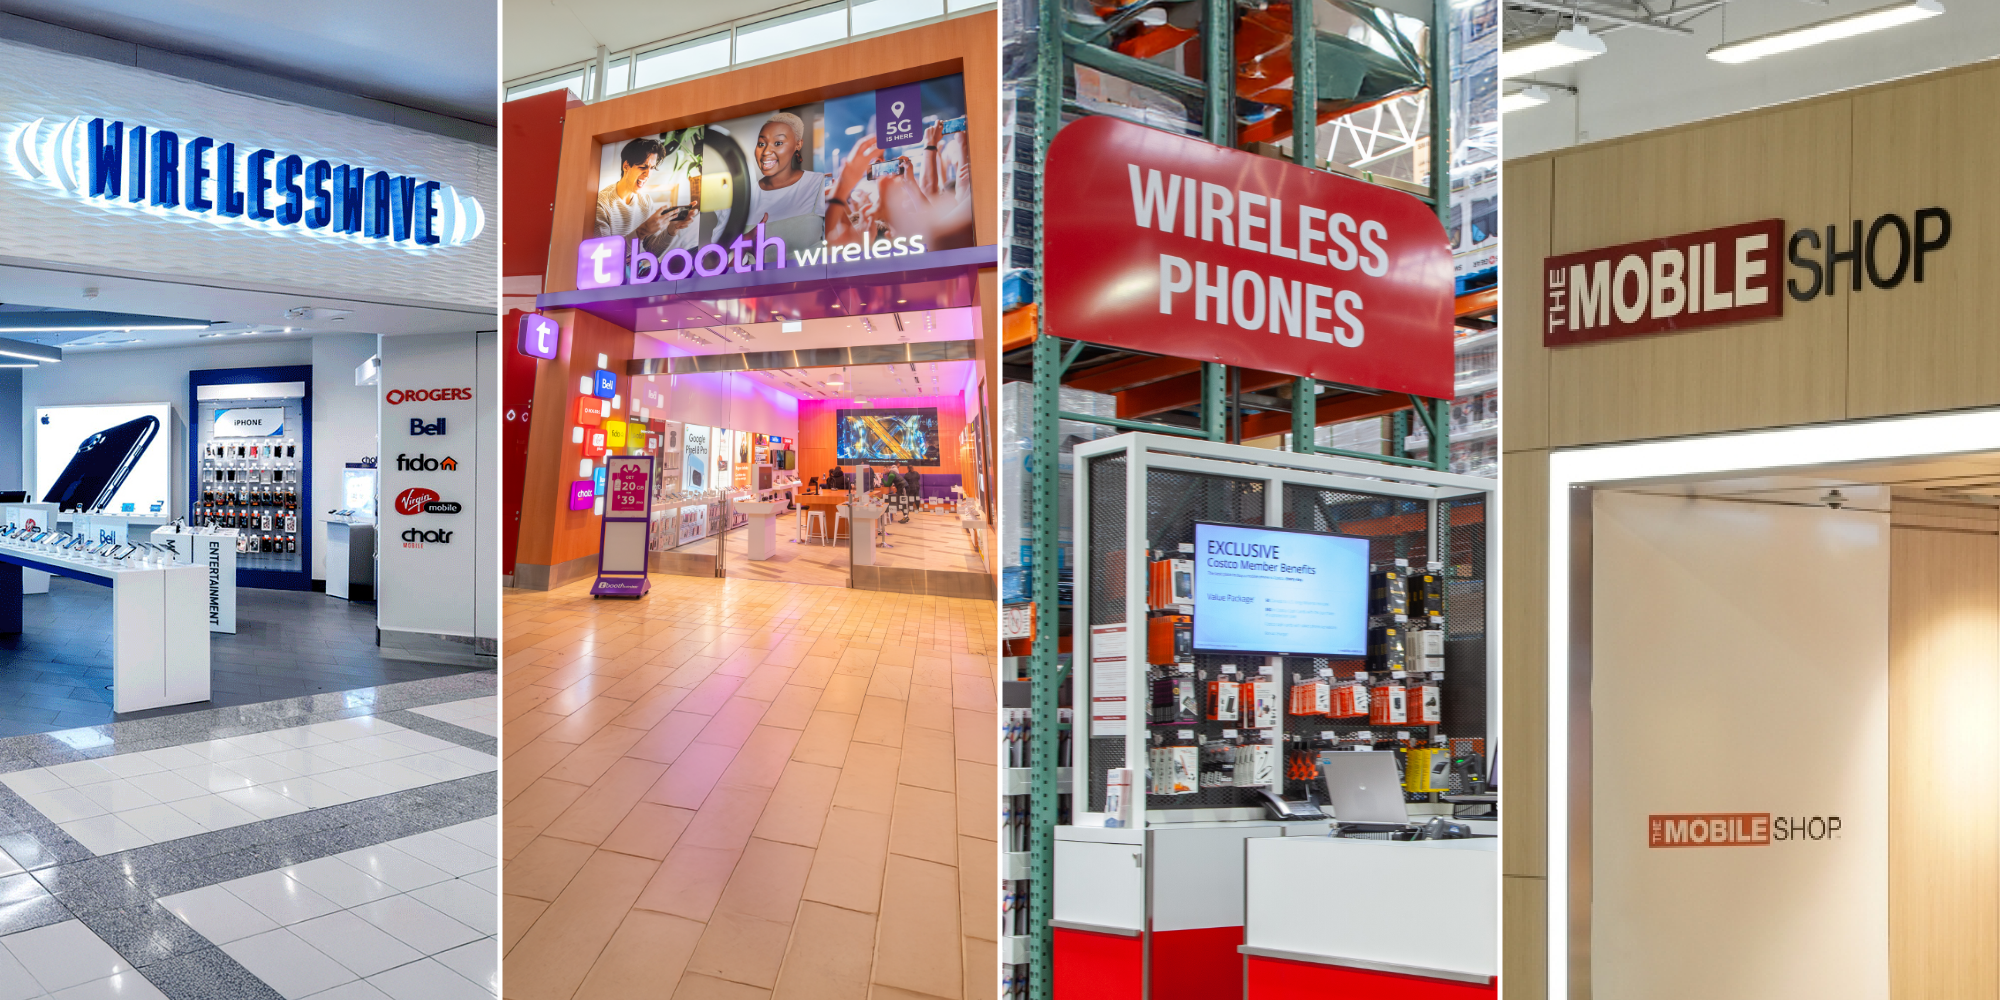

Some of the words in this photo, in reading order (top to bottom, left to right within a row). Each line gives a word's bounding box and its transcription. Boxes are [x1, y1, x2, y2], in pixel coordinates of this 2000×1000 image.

[886, 119, 912, 135] 5G
[894, 132, 914, 141] HERE
[87, 117, 441, 246] WIRELESSWAVE
[1128, 163, 1390, 277] WIRELESS
[630, 223, 787, 285] booth
[794, 231, 925, 267] wireless
[1549, 267, 1566, 333] THE
[1568, 233, 1769, 331] MOBILE
[1786, 206, 1952, 302] SHOP
[1159, 254, 1366, 348] PHONES
[601, 378, 614, 390] Bell
[405, 387, 473, 402] ROGERS
[409, 417, 447, 436] Bell
[611, 429, 621, 438] fido
[688, 433, 706, 446] Google
[685, 445, 697, 455] Pixel
[700, 446, 708, 455] Pro
[396, 453, 439, 472] fido
[621, 481, 636, 491] 20
[401, 488, 433, 512] Virgin
[428, 503, 458, 512] mobile
[100, 528, 116, 545] Bell
[401, 527, 454, 544] chatr
[1207, 539, 1280, 560] EXCLUSIVE
[1207, 557, 1238, 570] Costco
[1240, 559, 1279, 572] Member
[1280, 562, 1317, 575] Benefits
[209, 541, 220, 626] ENTERTAINMENT
[1207, 593, 1226, 602] Value
[1227, 594, 1254, 605] Package
[1652, 819, 1662, 844] THE
[1665, 816, 1768, 843] MOBILE
[1772, 815, 1842, 841] SHOP
